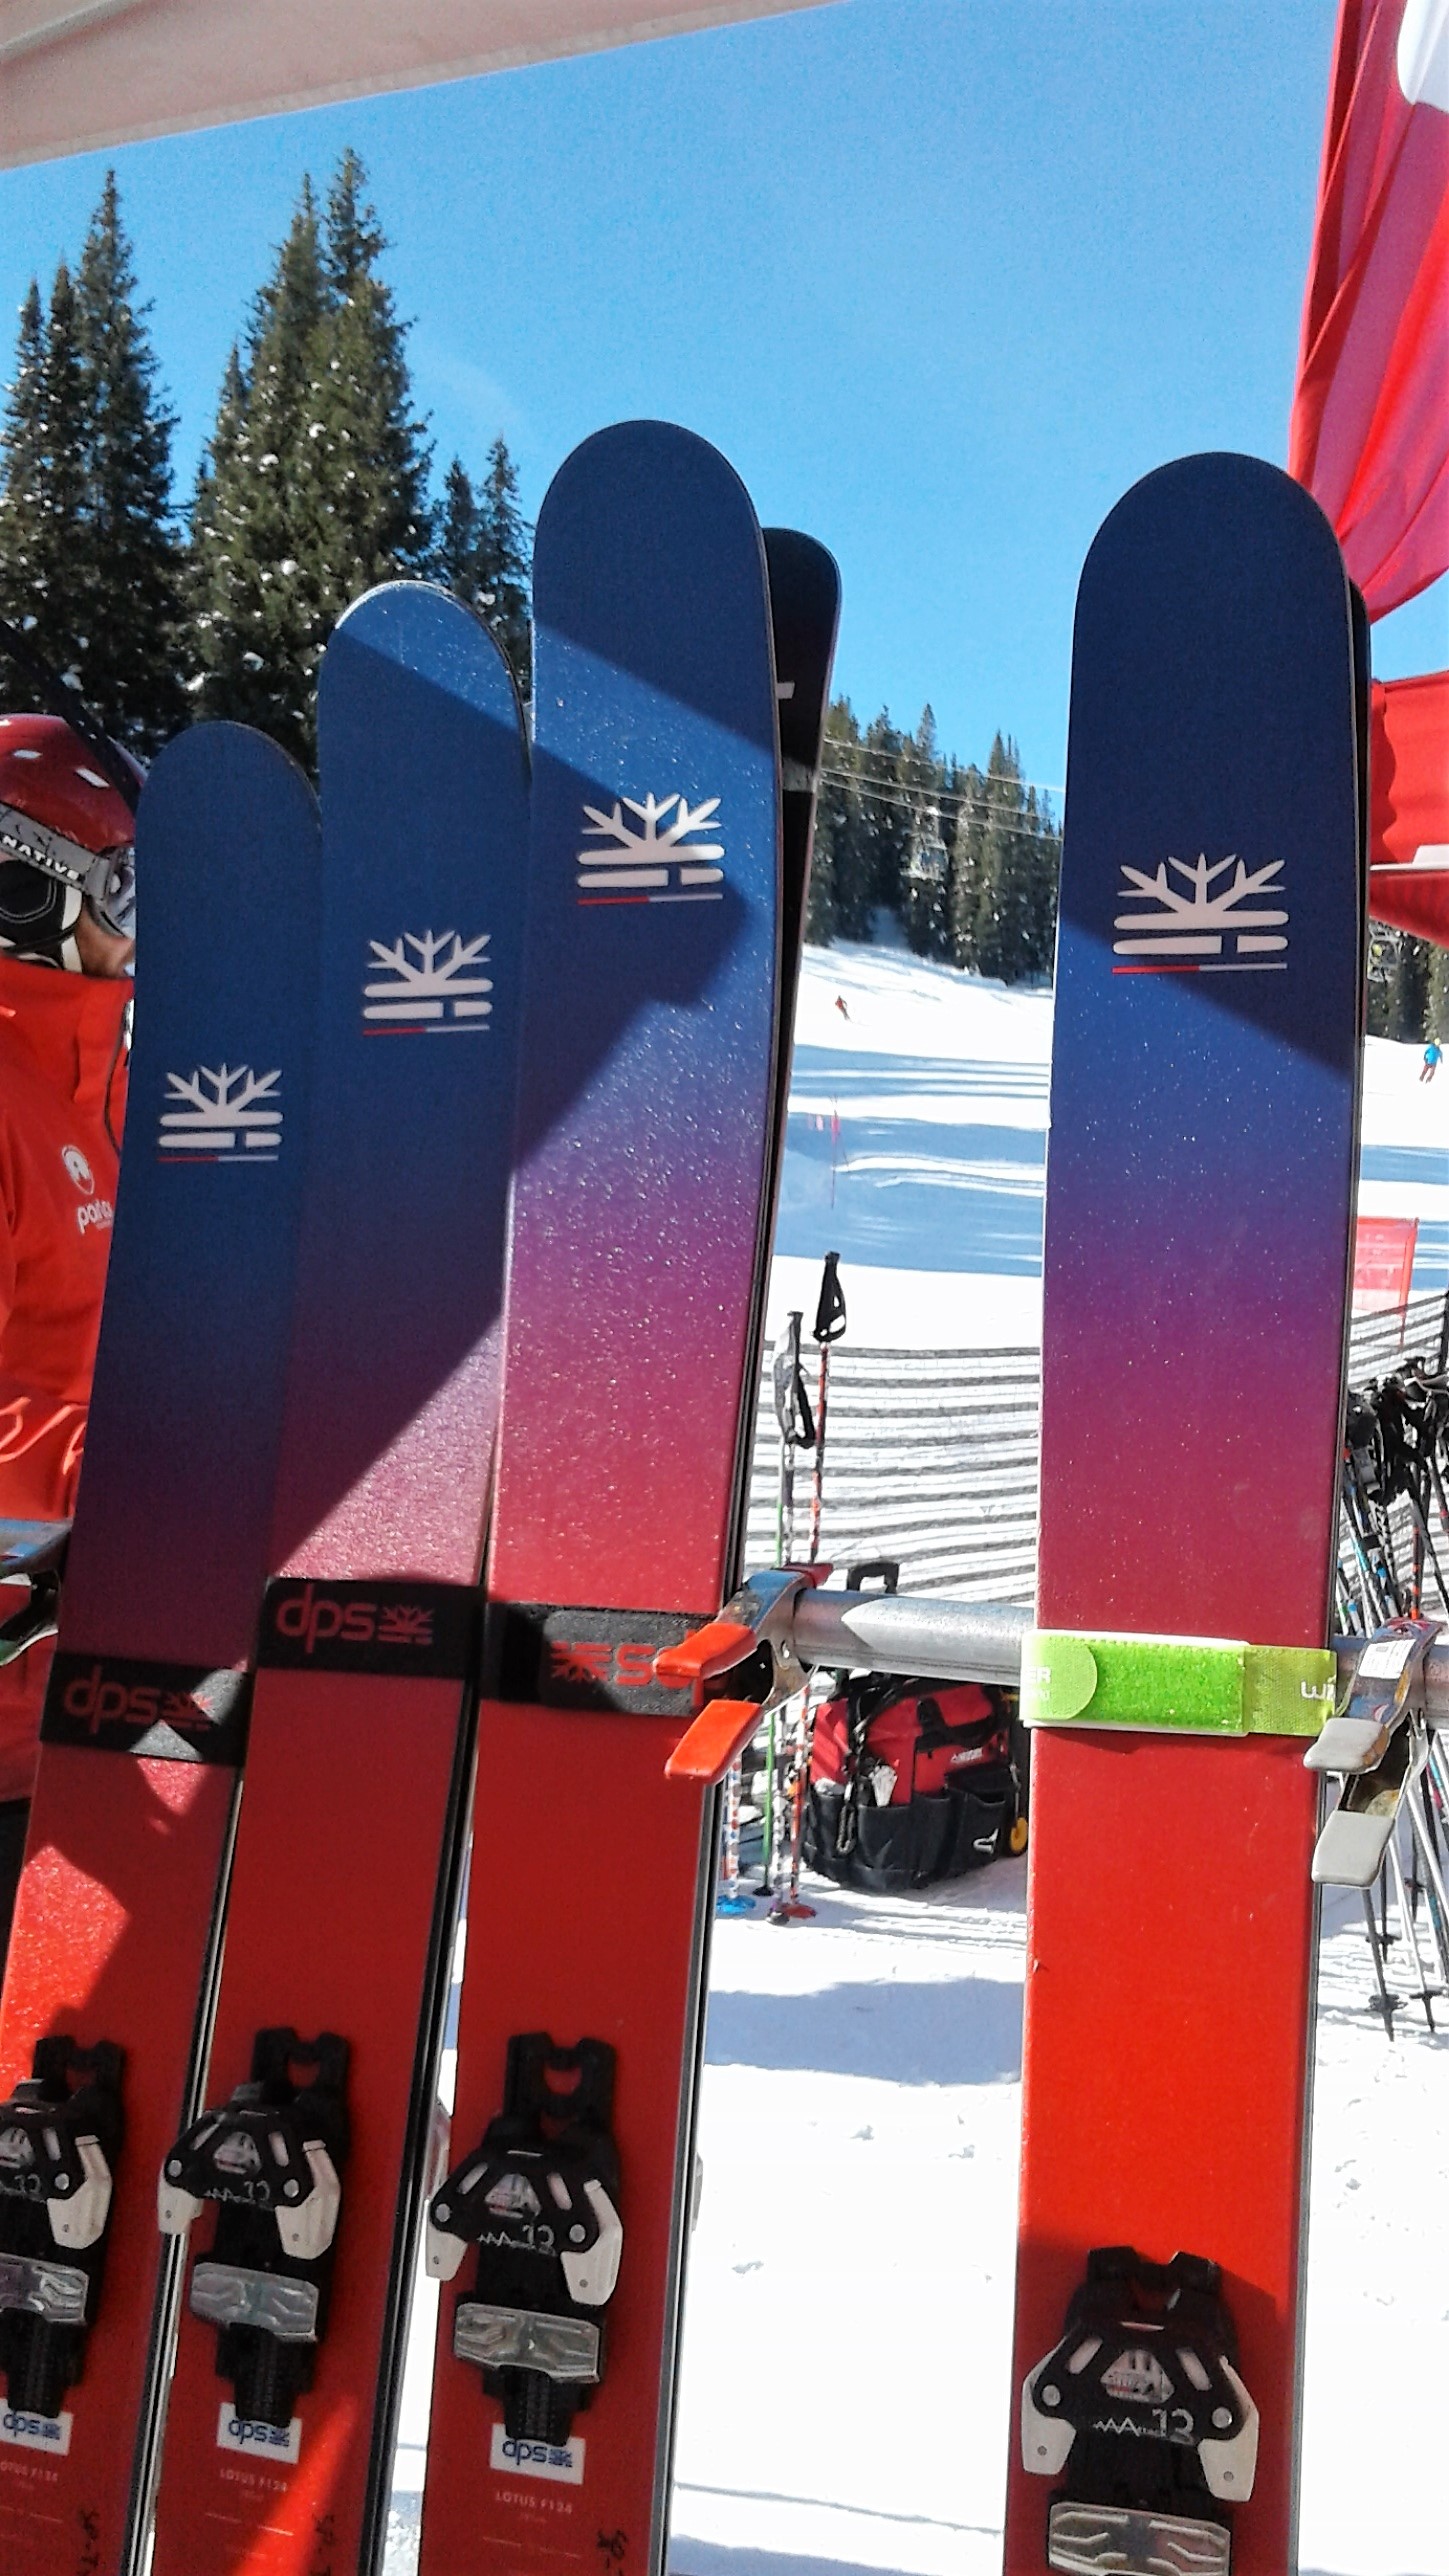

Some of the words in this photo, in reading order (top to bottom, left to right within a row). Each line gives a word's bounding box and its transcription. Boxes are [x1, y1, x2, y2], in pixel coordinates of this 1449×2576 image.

[2, 835, 80, 881] NATIVE
[277, 1583, 377, 1654] dps
[63, 1664, 161, 1734] dps
[496, 2491, 535, 2508] LOTUS
